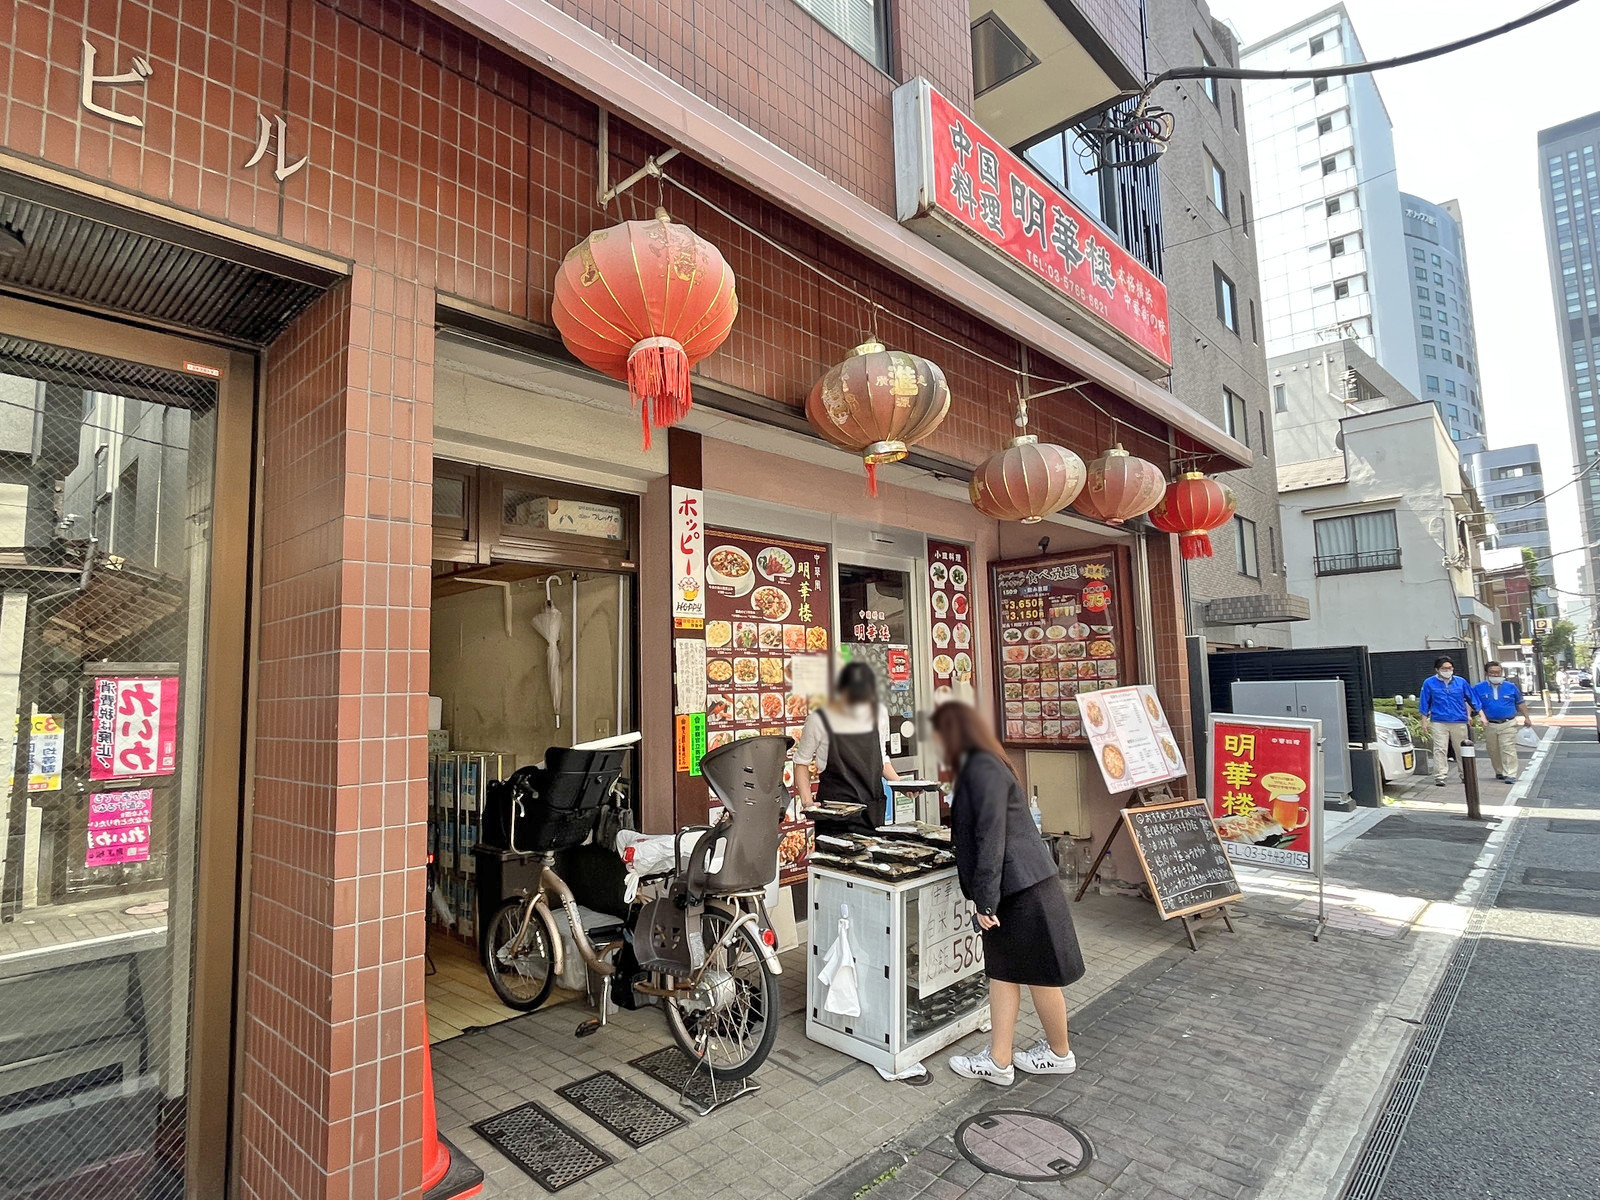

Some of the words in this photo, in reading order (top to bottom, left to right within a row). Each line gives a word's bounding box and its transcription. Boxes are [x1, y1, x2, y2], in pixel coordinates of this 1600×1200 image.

[82, 39, 309, 182] ビル
[948, 119, 1000, 195] 中国
[950, 164, 1006, 240] 料理
[1009, 172, 1117, 299] 明華楼
[678, 491, 701, 576] ホッピー
[797, 561, 813, 622] 明華楼
[1026, 564, 1079, 584] 食べ放題
[1221, 733, 1258, 818] 明華楼
[953, 934, 983, 974] 580
